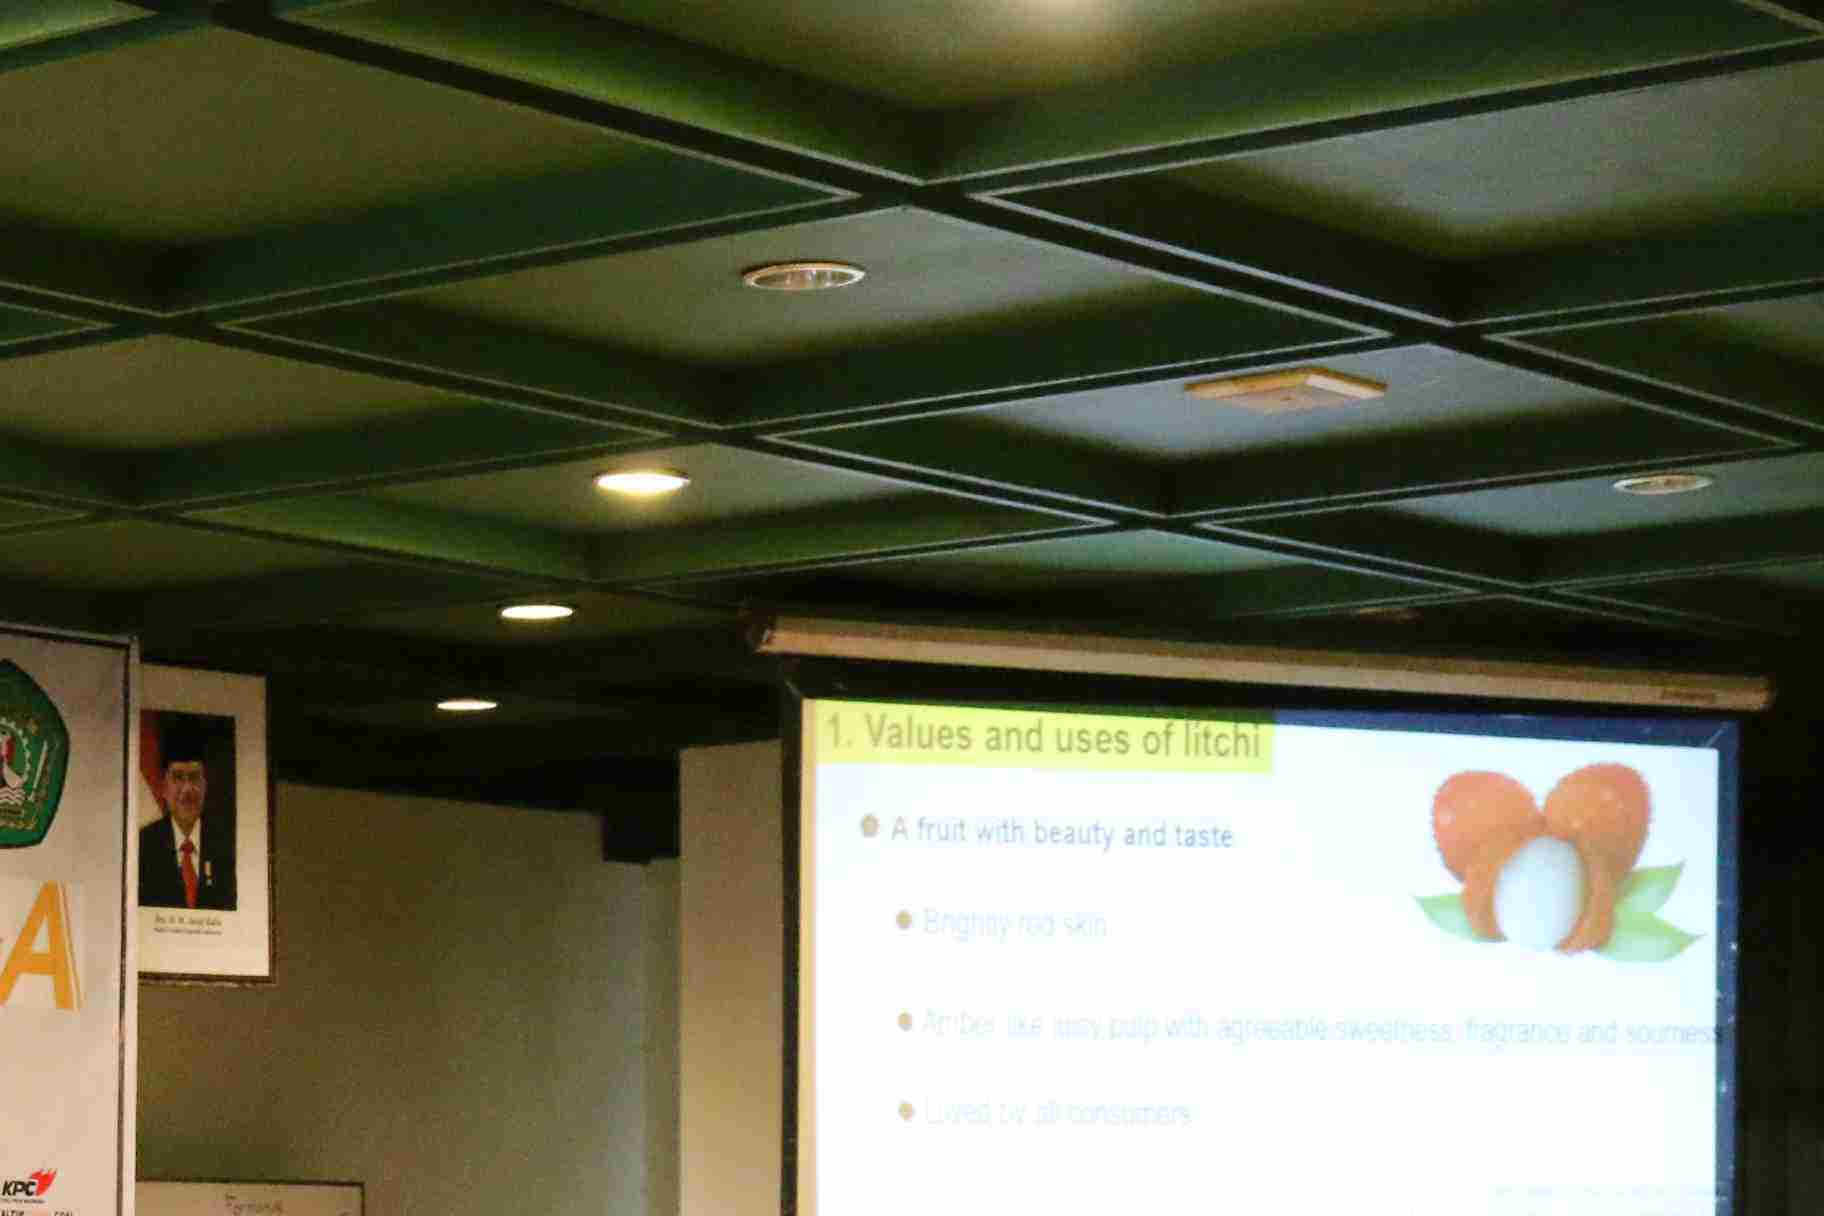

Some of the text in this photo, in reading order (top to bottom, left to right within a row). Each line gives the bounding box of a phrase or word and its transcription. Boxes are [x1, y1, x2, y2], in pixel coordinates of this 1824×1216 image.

[865, 713, 972, 751] Values
[985, 717, 1043, 752] and
[1056, 725, 1129, 755] uses
[1143, 720, 1175, 755] of
[1184, 721, 1260, 758] litchi
[891, 815, 1233, 854] A fruit with beauty and taste
[2, 1180, 37, 1197] KPC
